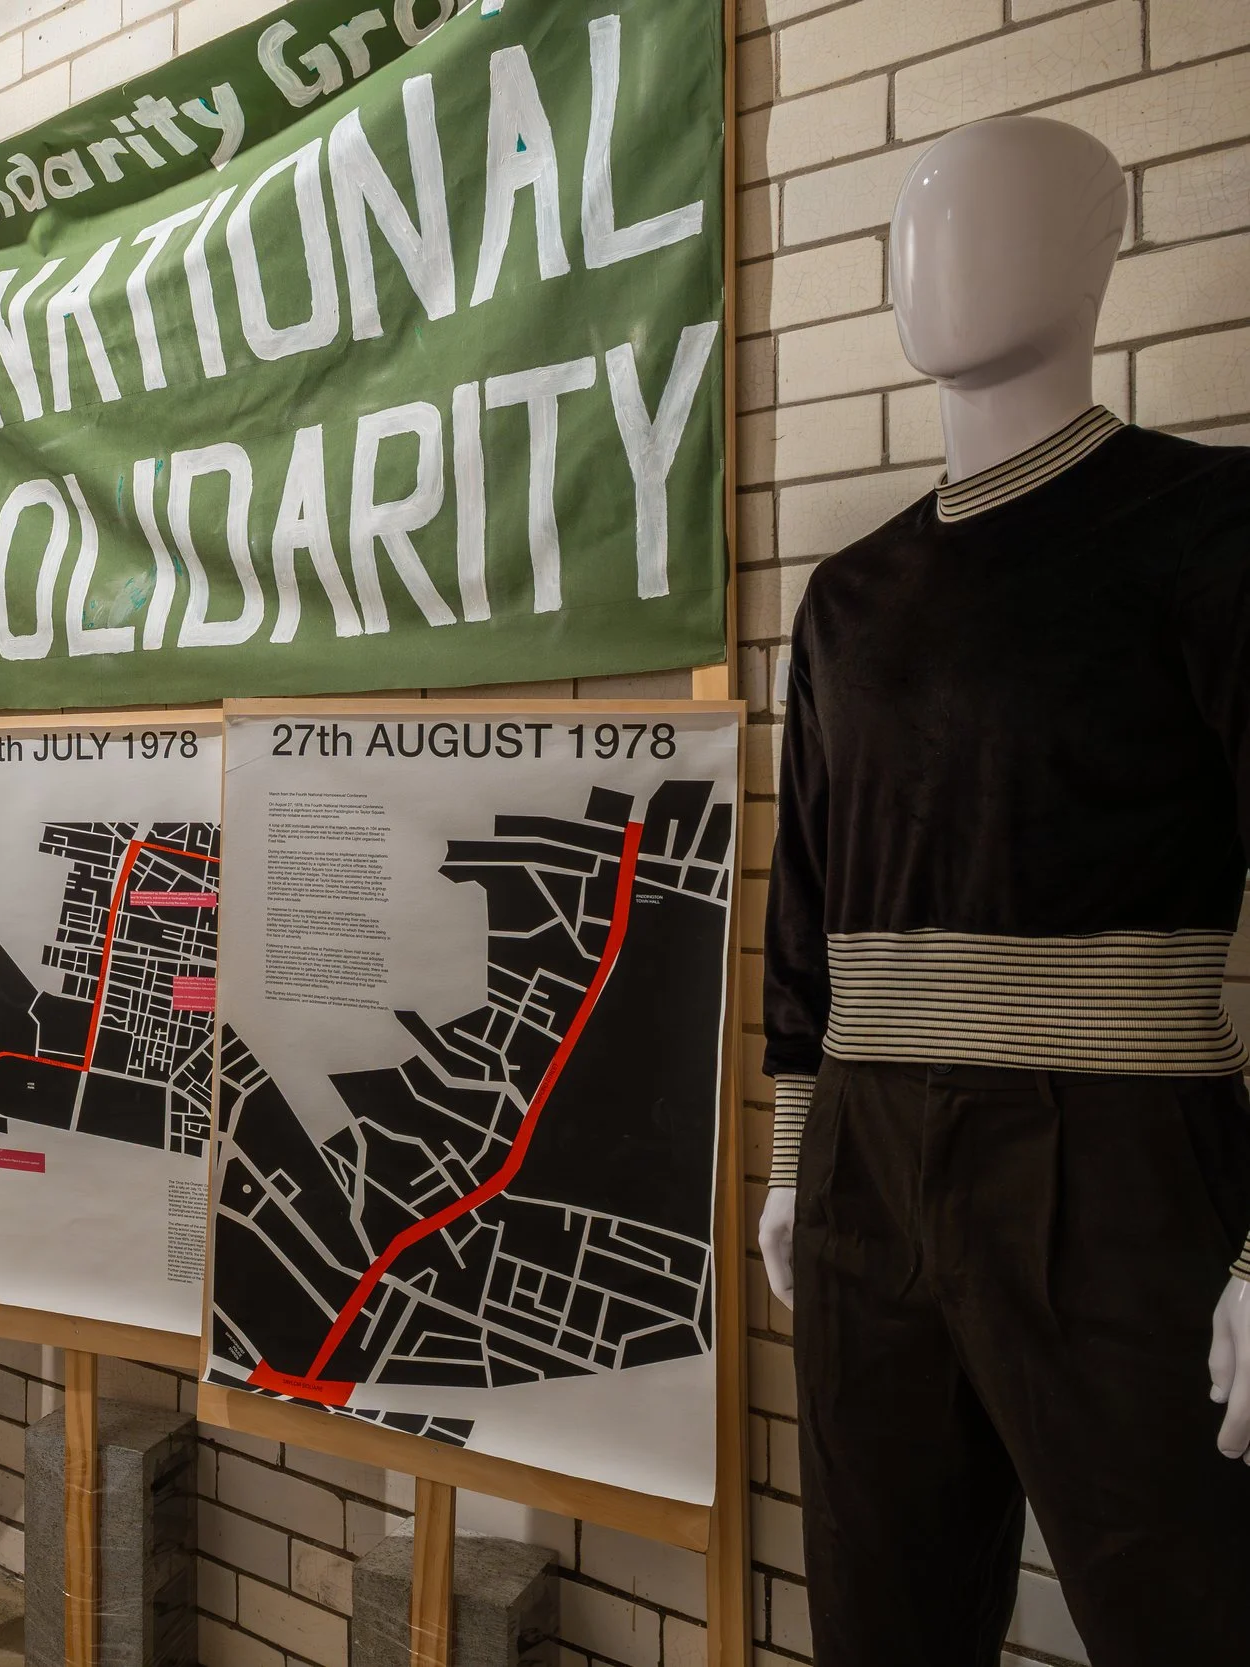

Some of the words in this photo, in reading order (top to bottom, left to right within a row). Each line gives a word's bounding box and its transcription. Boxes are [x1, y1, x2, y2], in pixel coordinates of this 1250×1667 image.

[258, 0, 504, 107] Gro
[33, 732, 111, 762] JULY
[122, 730, 198, 760] 1978
[272, 723, 352, 757] 27th
[366, 722, 552, 758] AUGUST
[568, 722, 676, 760] 1978
